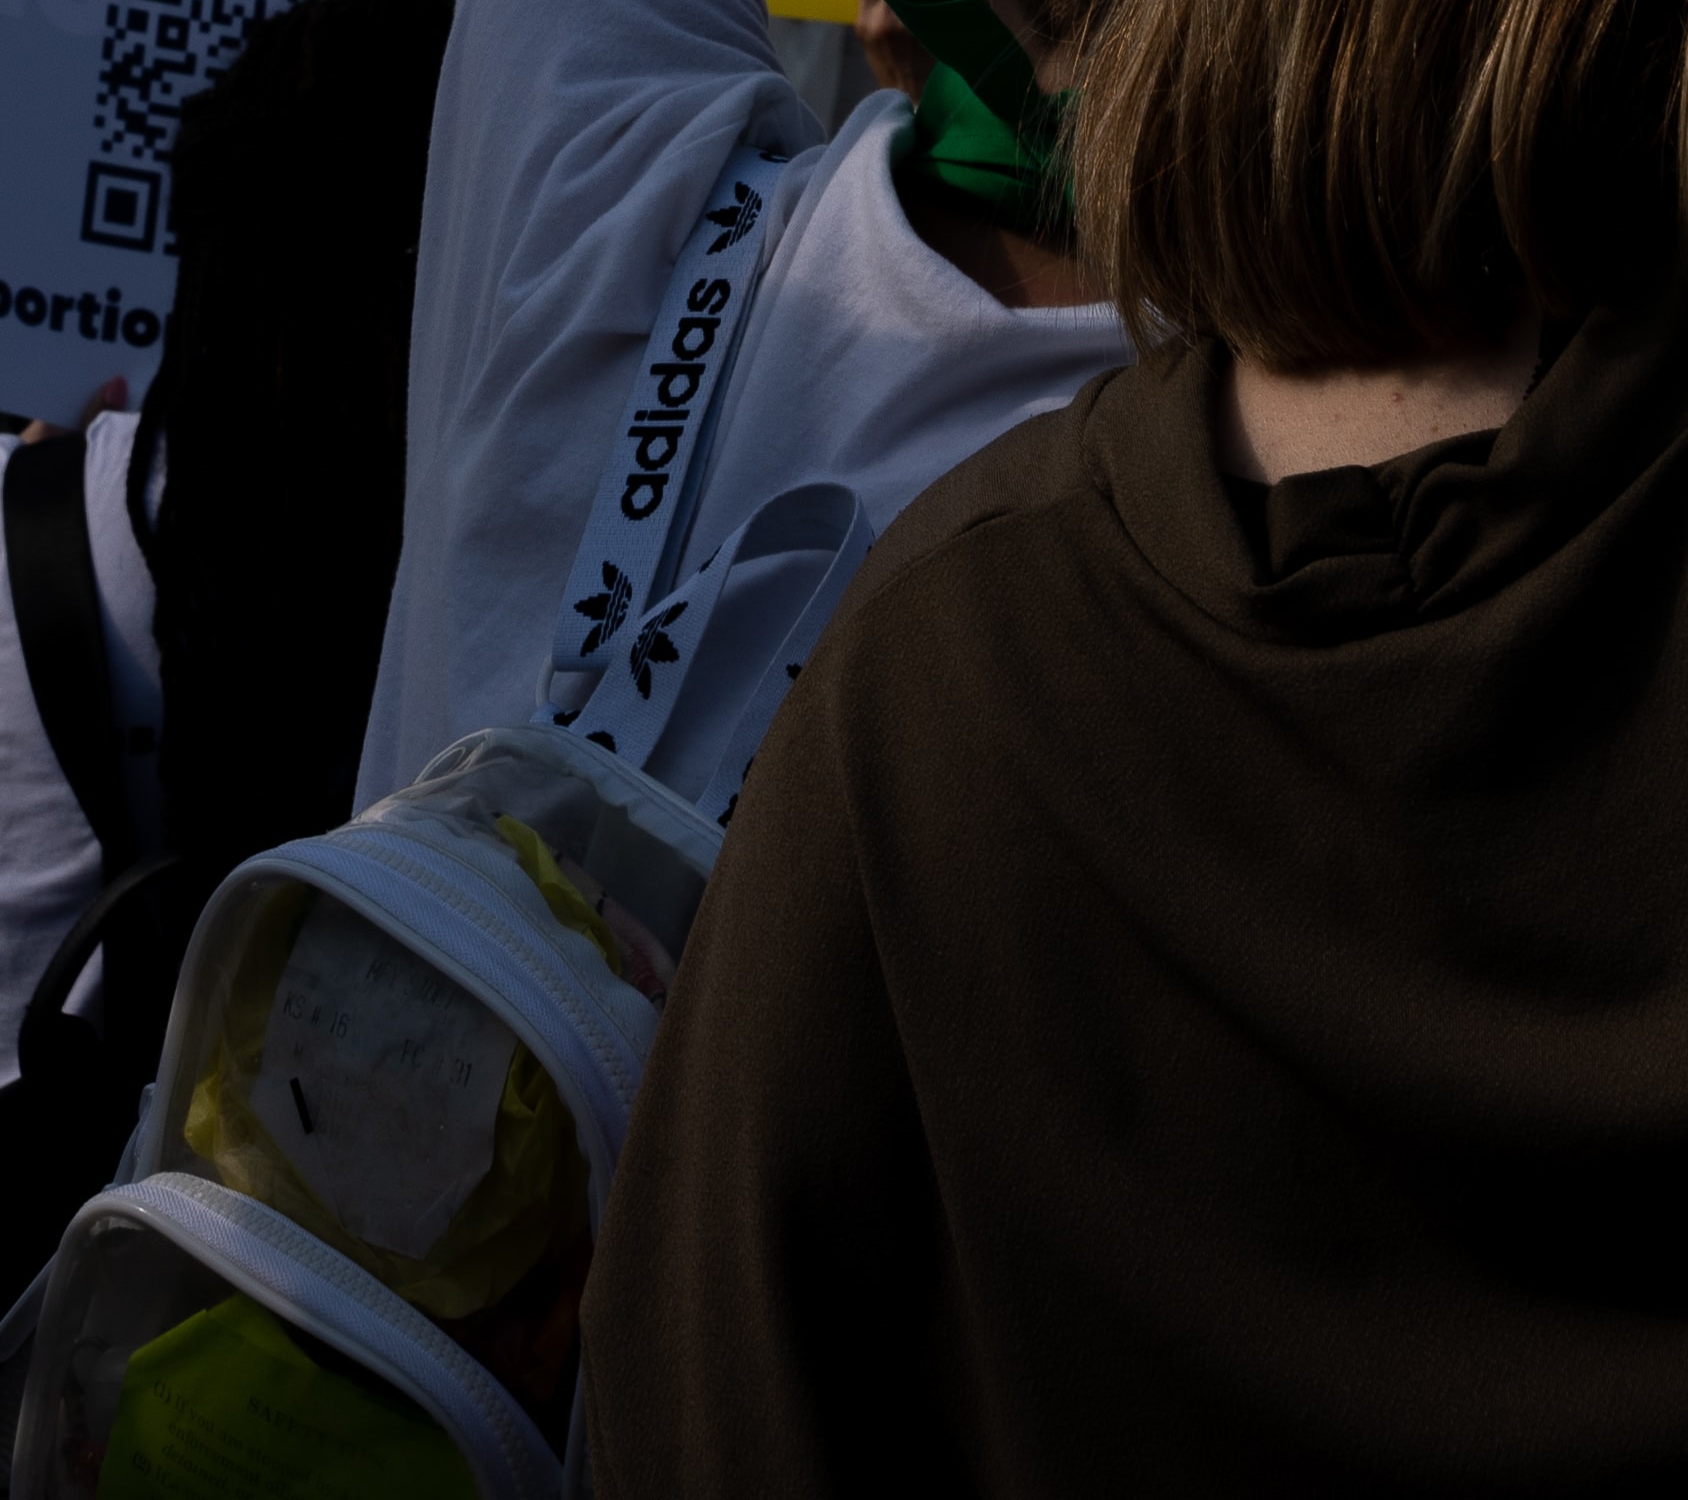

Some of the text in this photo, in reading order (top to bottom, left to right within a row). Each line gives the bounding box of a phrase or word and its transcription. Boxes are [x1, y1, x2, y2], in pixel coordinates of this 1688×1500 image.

[0, 279, 174, 348] ortio
[620, 278, 731, 521] adidas
[189, 1409, 215, 1434] you
